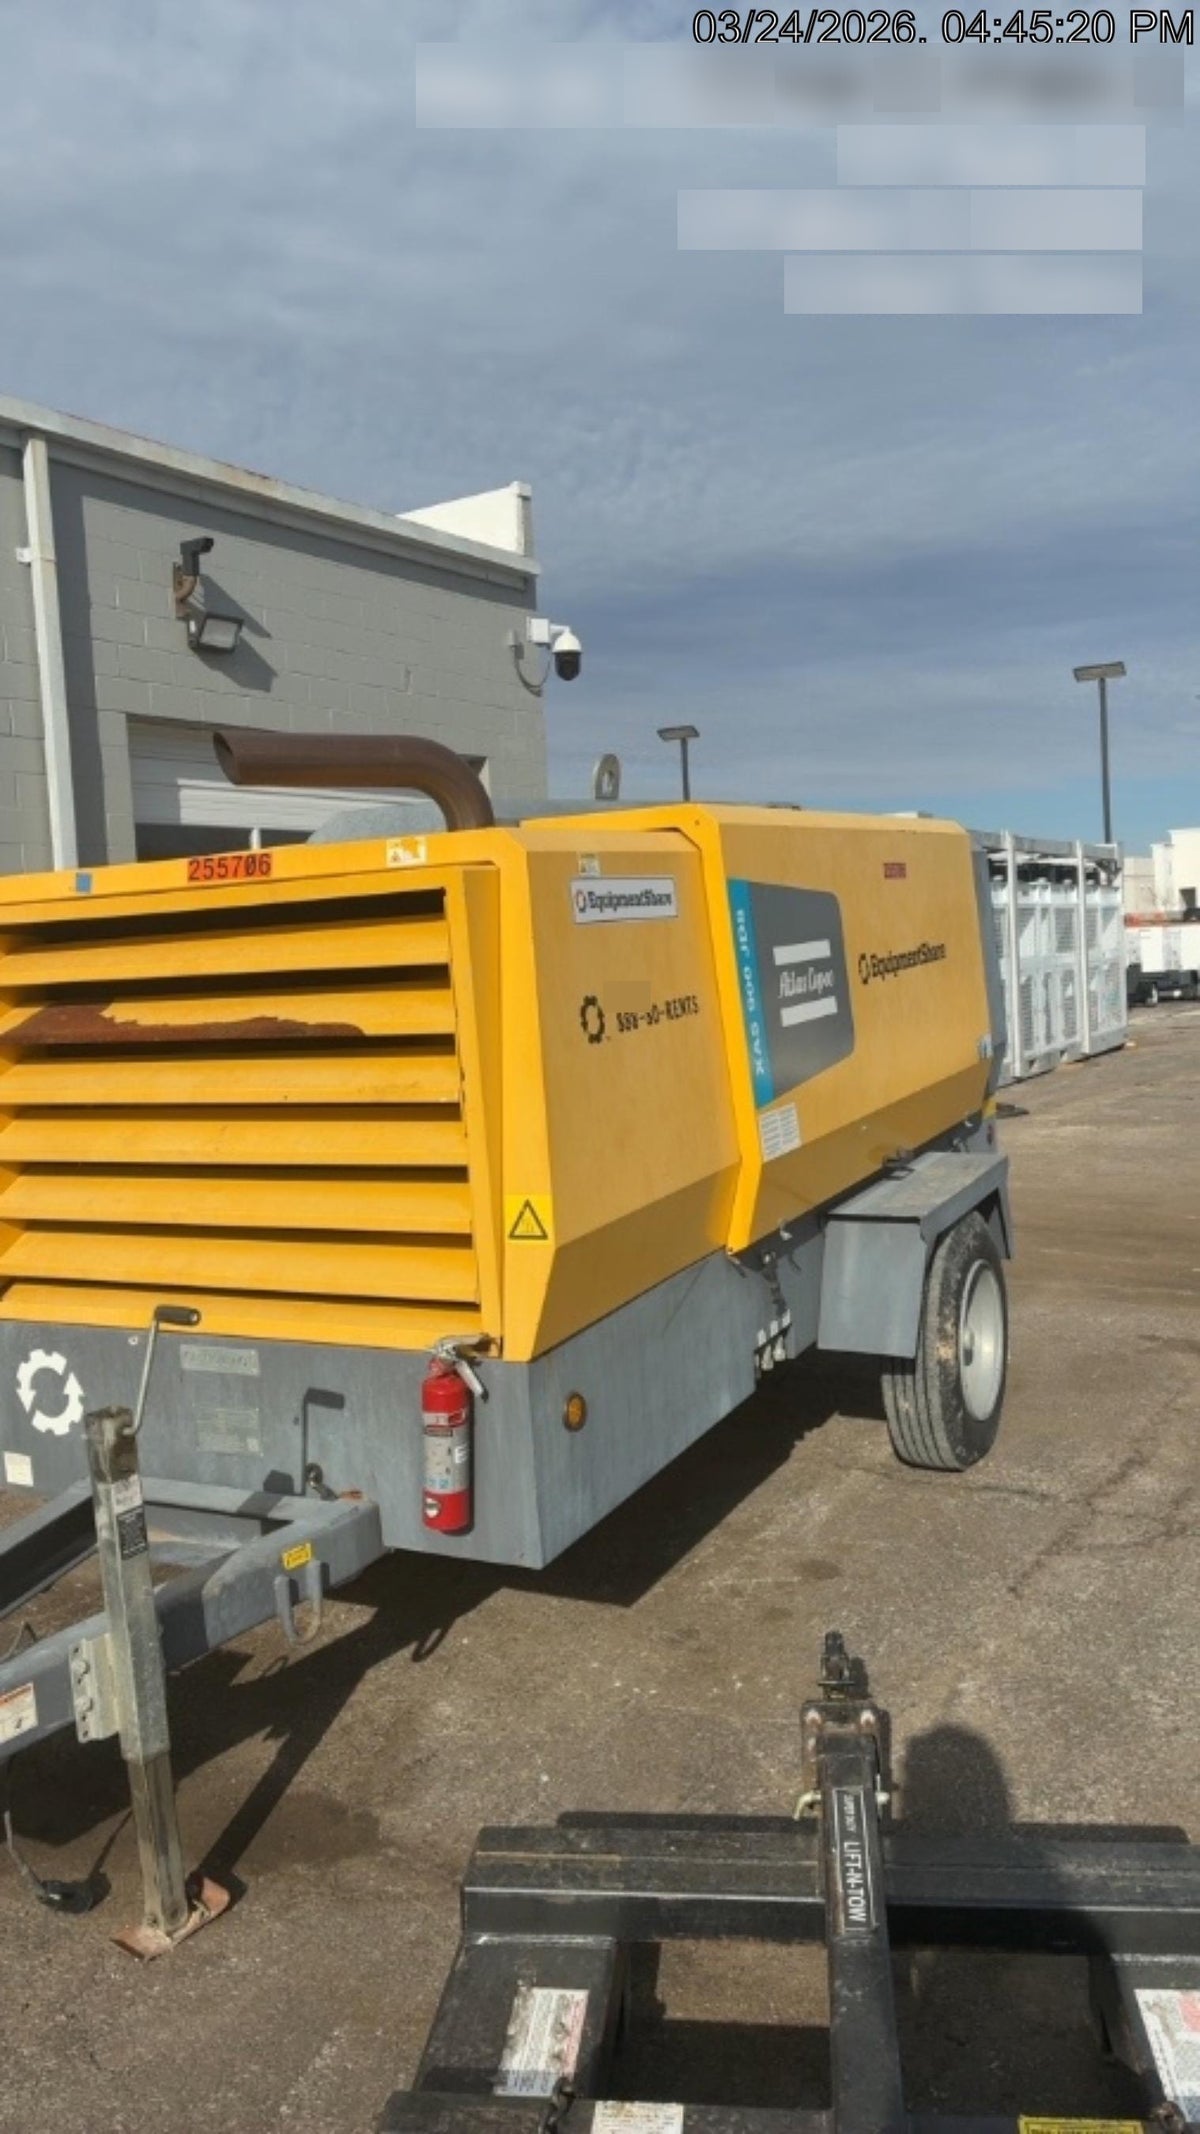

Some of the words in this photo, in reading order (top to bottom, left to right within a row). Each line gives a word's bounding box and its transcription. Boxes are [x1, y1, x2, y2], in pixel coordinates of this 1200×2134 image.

[188, 854, 271, 881] 255706
[587, 889, 672, 913] EquipmentShare
[869, 943, 946, 981] EquipmentShare
[778, 970, 807, 998] Atlas
[808, 966, 834, 994] Copco
[844, 1841, 867, 1922] LIFT-N-TOW
